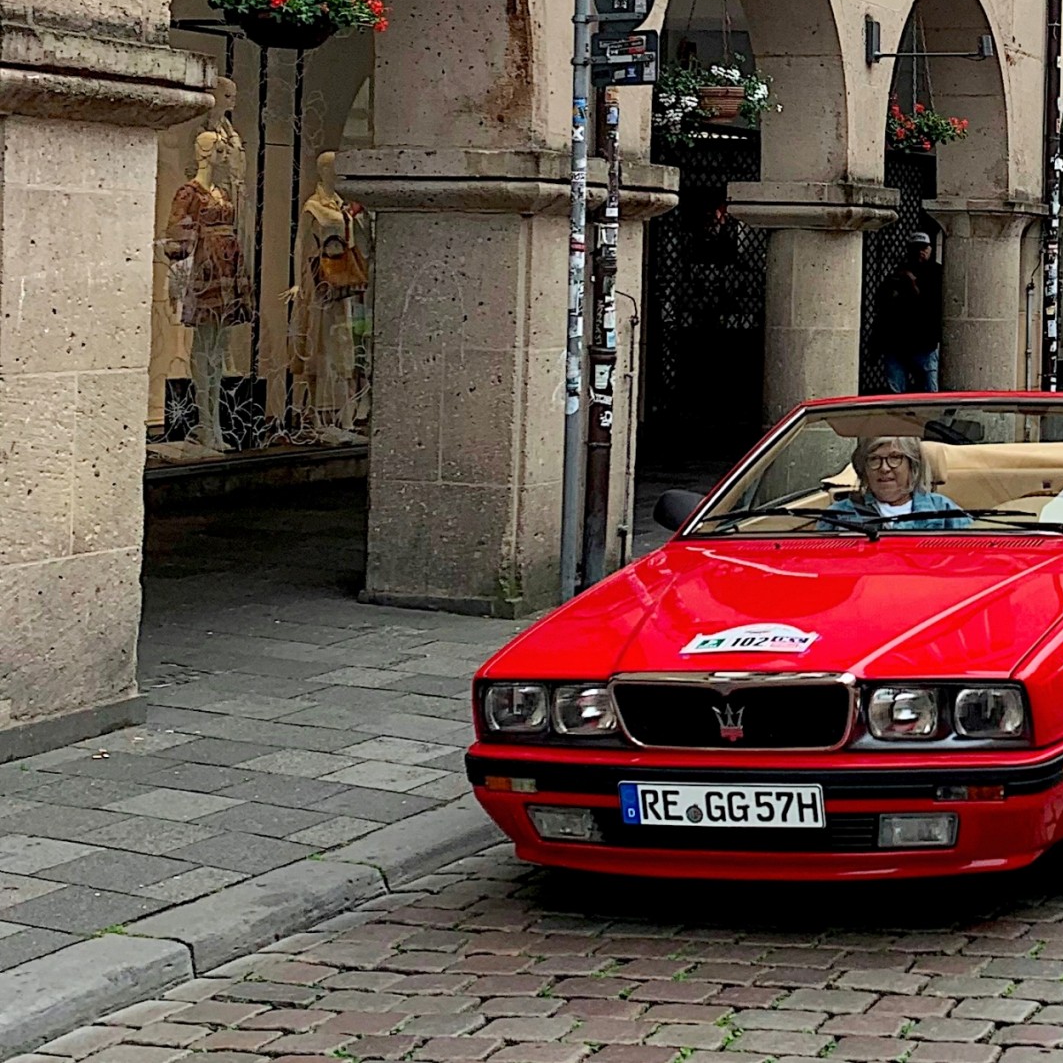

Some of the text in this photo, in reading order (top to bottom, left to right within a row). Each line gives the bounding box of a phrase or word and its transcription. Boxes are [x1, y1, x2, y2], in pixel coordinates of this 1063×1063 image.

[731, 637, 769, 647] 102
[640, 789, 684, 821] RE
[628, 808, 636, 818] D
